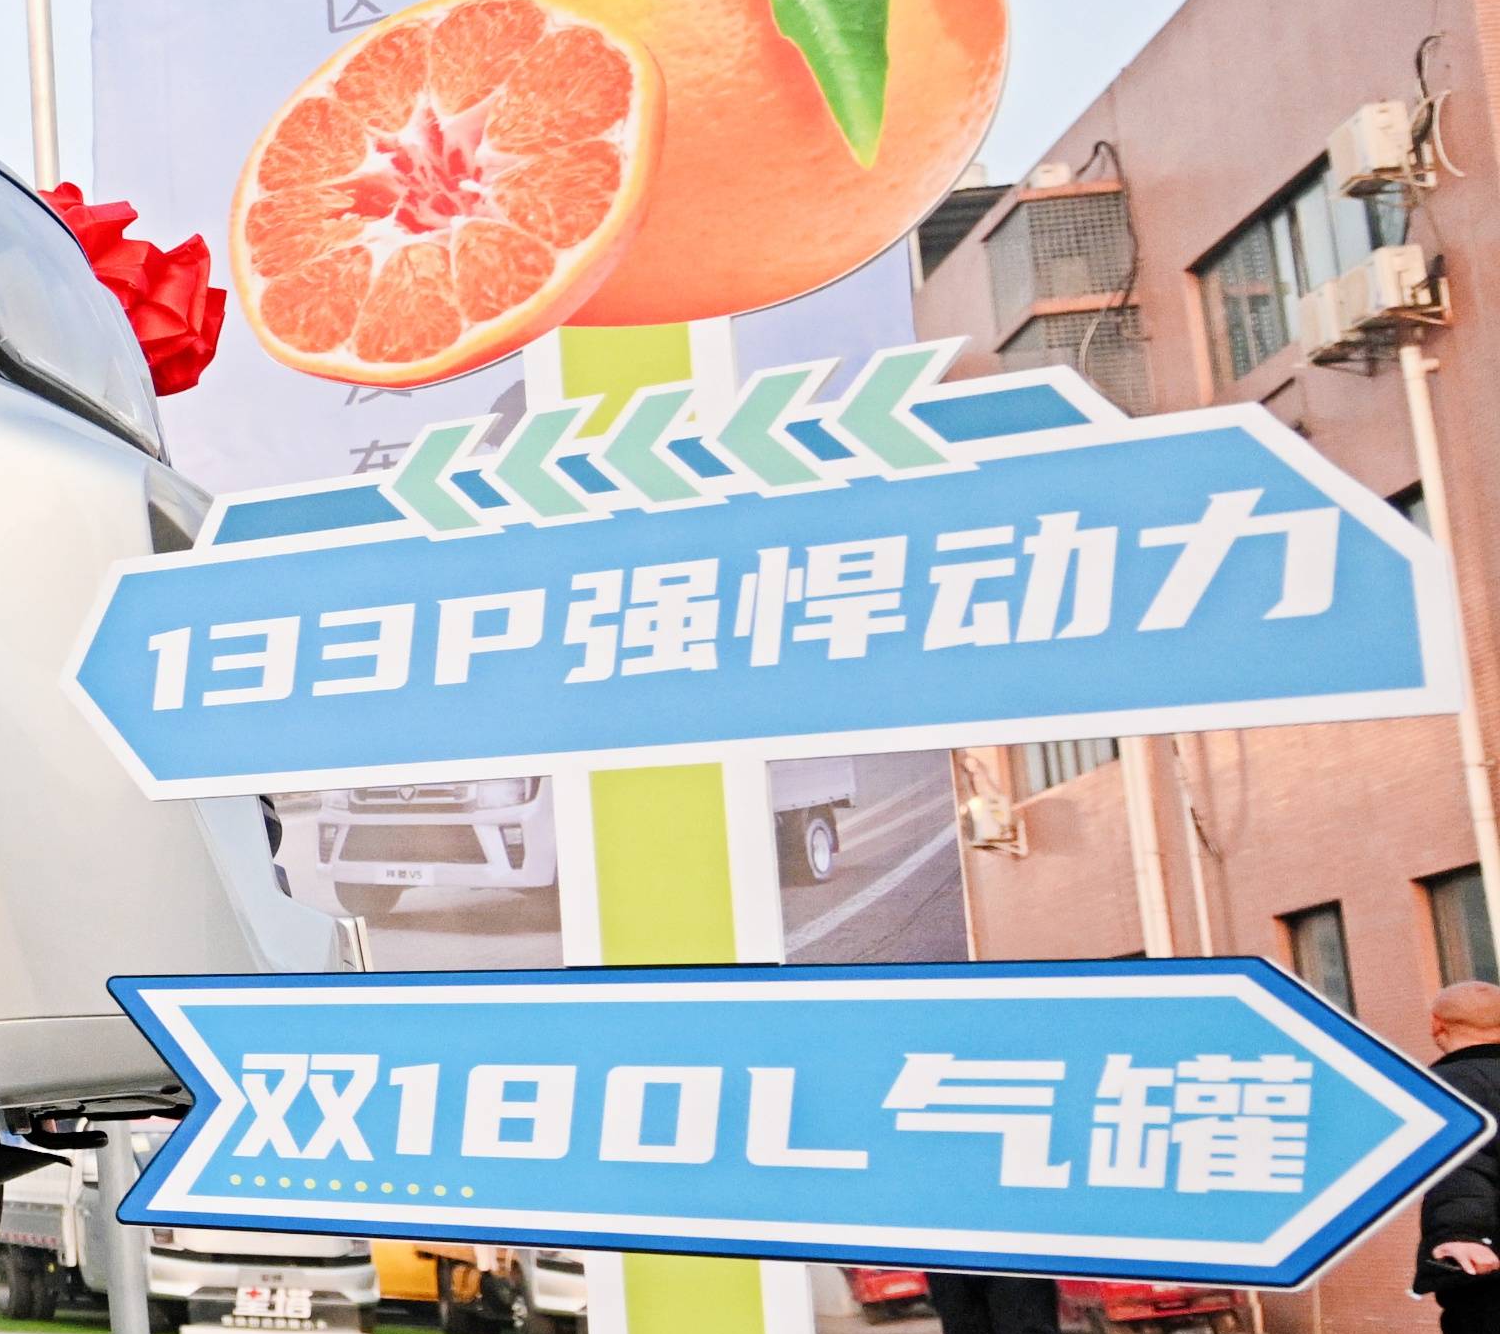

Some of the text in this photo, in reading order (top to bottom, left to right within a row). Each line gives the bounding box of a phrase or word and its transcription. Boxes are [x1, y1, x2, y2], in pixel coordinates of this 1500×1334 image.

[146, 489, 1340, 711] 133P强悍动力
[231, 1052, 1315, 1195] 双180L气罐
